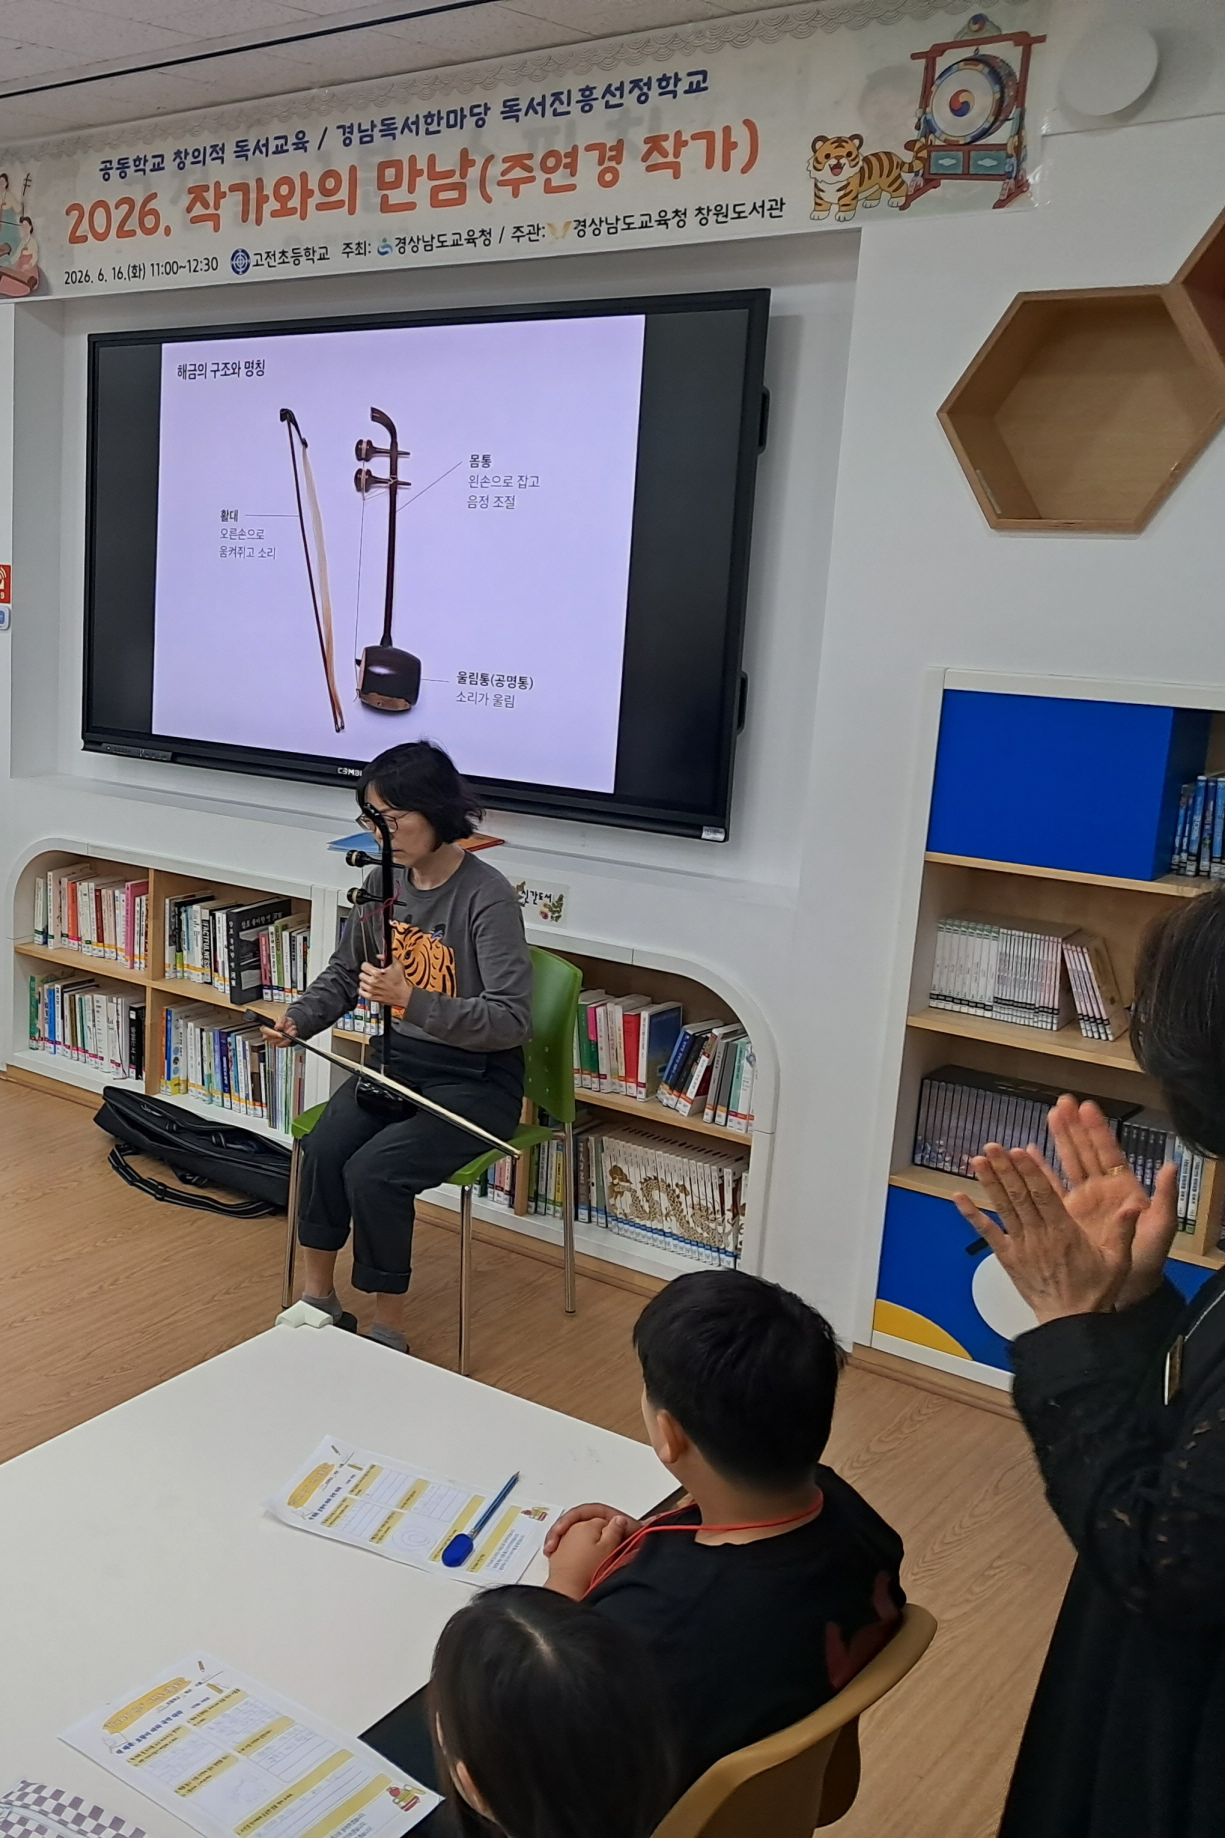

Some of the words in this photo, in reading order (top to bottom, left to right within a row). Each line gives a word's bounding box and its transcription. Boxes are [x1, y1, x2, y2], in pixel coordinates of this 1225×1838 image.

[99, 153, 166, 182] 공동학교
[173, 142, 226, 171] 창의적
[233, 130, 310, 161] 독서교육
[317, 126, 328, 151] /
[336, 101, 491, 148] 경남독서한마당
[500, 69, 709, 123] 독서진흥선정학교
[65, 192, 172, 245] 2026.
[186, 164, 358, 233] 작가와의
[376, 138, 625, 214] 만남(주연경
[640, 118, 759, 180] 작가)
[64, 270, 94, 285] 2026.
[97, 268, 108, 283] 6.
[112, 263, 147, 281] 16.(화)
[150, 256, 219, 278] 11:00~12:30
[252, 245, 331, 269] 고전초등학교
[341, 241, 372, 259] 주최:
[394, 228, 492, 255] 경상남도교육청
[498, 226, 506, 244] /
[510, 223, 546, 243] 주관:
[573, 207, 688, 238] 경상남도교육청
[694, 197, 786, 223] 창원도서관
[177, 362, 208, 380] 해금의
[210, 360, 241, 379] 구조와
[244, 359, 265, 377] 명칭
[469, 454, 492, 469] 몸통
[468, 474, 514, 489] 왼손으로
[517, 474, 540, 489] 잡고
[467, 494, 489, 509] 음정
[493, 494, 516, 510] 조절
[220, 509, 239, 523] 활대
[220, 527, 265, 541] 오른손으로
[219, 545, 256, 559] 움켜쥐고
[258, 547, 276, 560] 소리
[456, 670, 534, 691] 울림통(공명통)
[456, 691, 490, 706] 소리가
[493, 693, 515, 709] 울림
[521, 889, 552, 905] 신간도서
